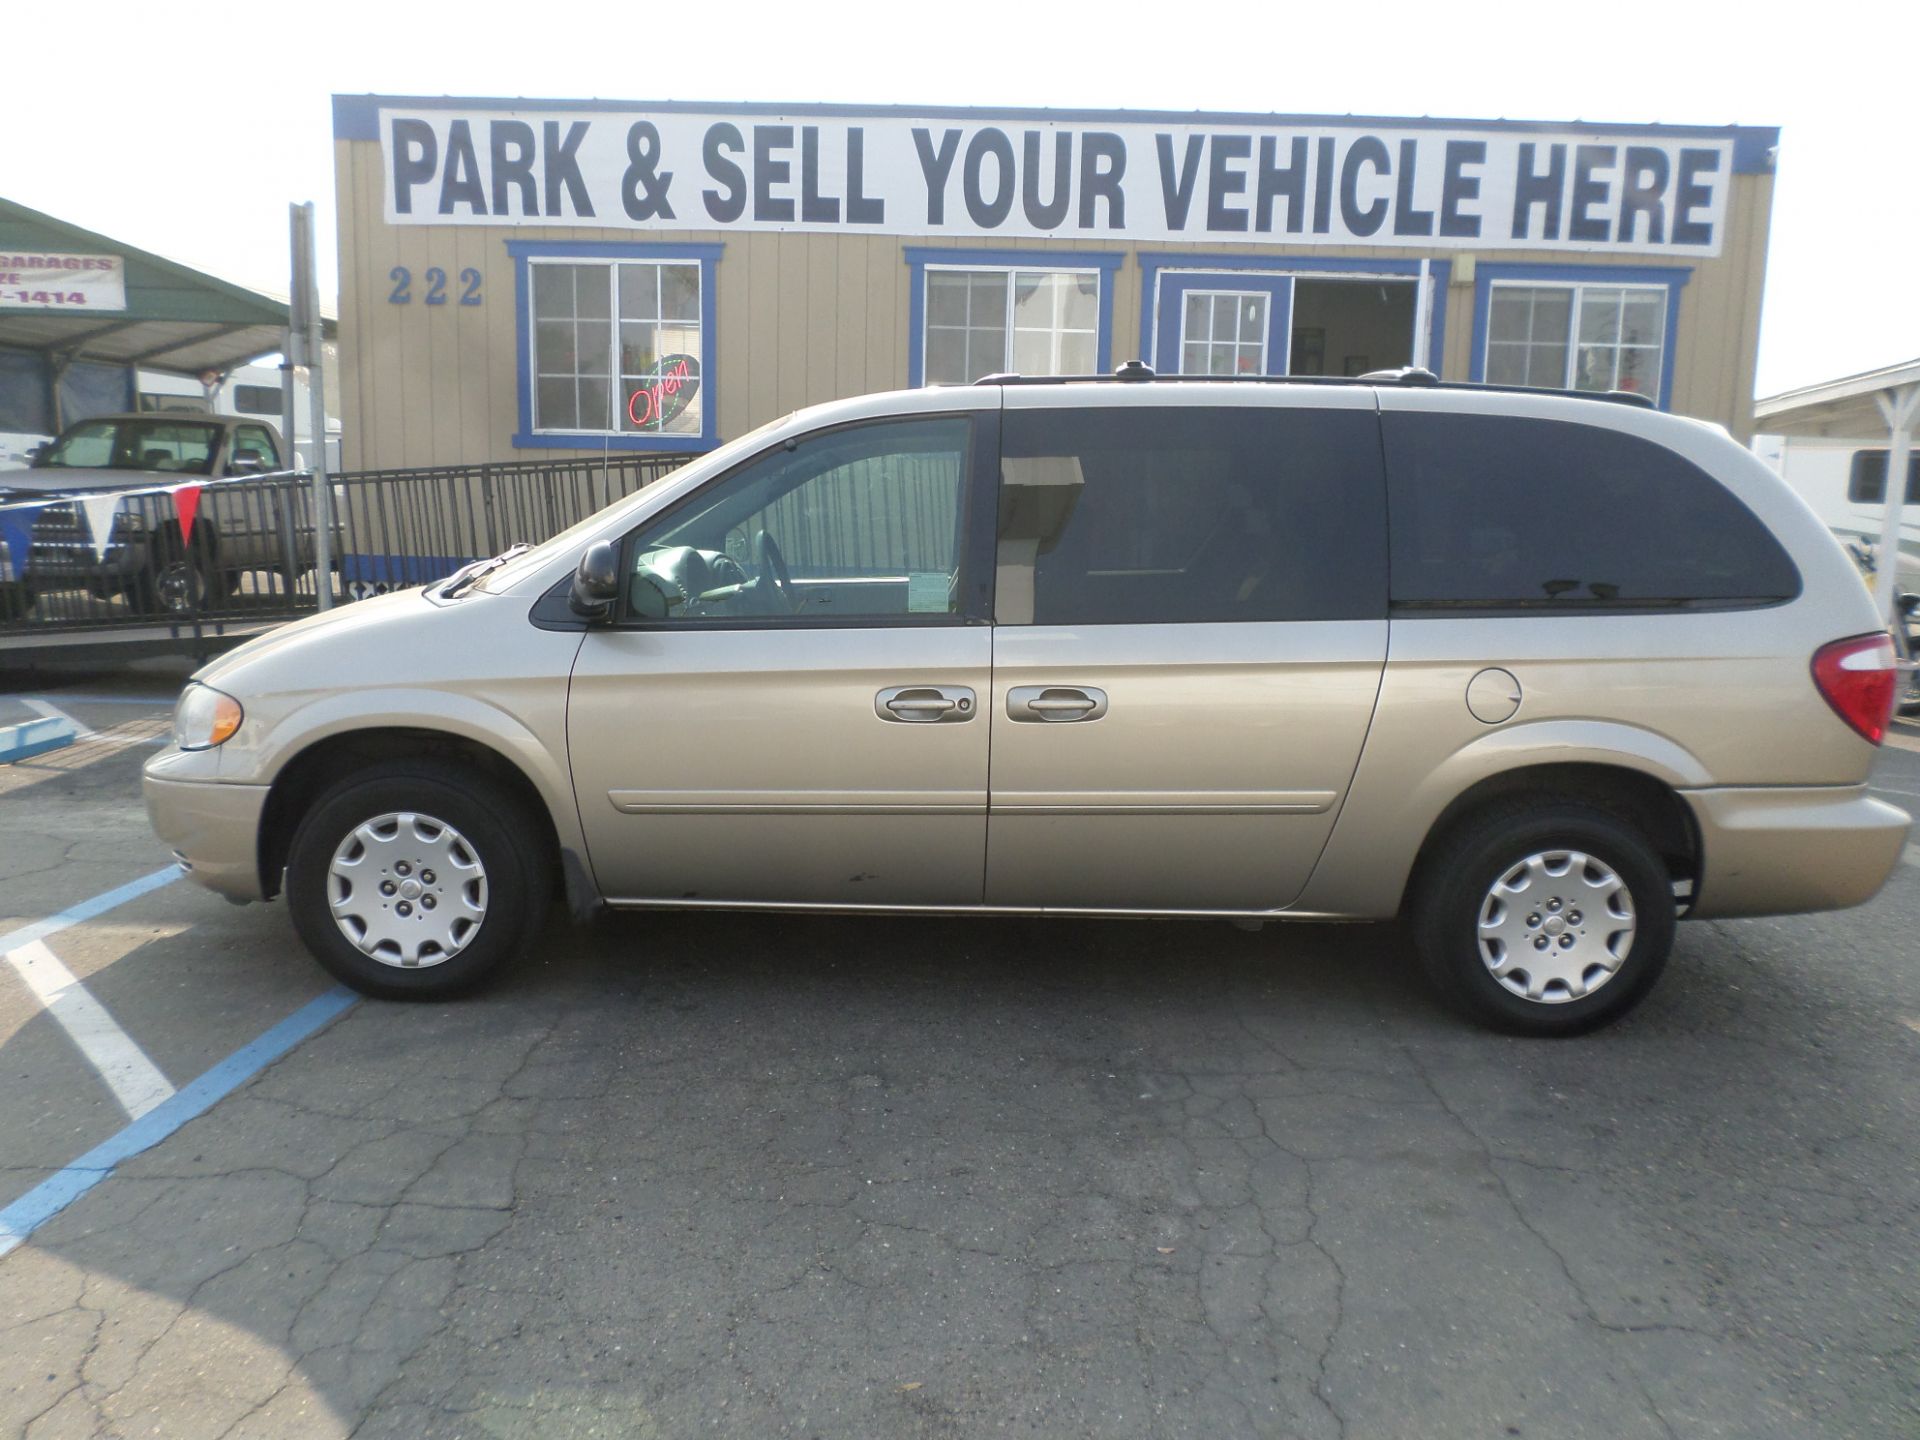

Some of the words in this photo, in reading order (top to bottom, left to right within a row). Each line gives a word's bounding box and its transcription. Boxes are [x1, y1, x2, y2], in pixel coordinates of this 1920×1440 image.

[391, 118, 596, 218] PARK
[621, 121, 677, 222] &
[702, 122, 885, 224] SELL
[911, 127, 1127, 230] YOUR
[1155, 133, 1487, 238] VEHICLE
[1510, 142, 1721, 246] HERE
[0, 290, 86, 304] -1414
[388, 266, 482, 306] 222
[629, 360, 690, 424] Open
